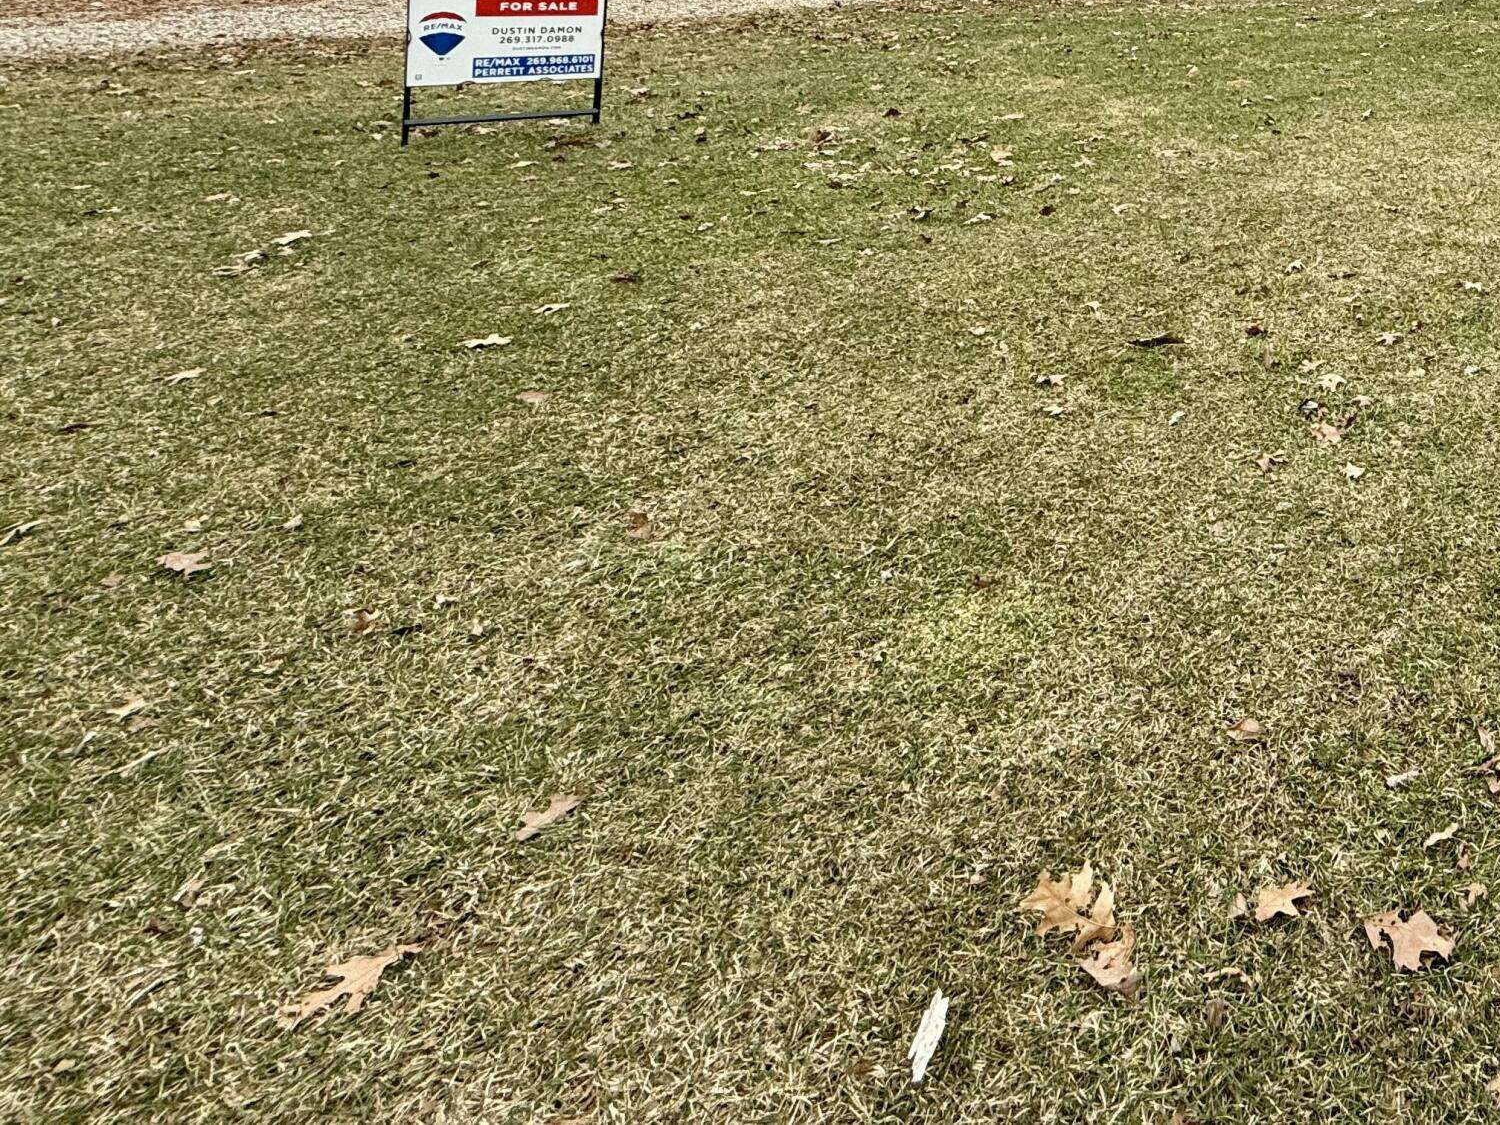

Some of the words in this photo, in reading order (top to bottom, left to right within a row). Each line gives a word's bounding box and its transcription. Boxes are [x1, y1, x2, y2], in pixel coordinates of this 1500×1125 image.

[500, 2, 533, 11] FOR
[538, 2, 578, 11] SALE
[423, 22, 463, 32] RE/MAX
[491, 27, 536, 35] DUSTIN
[540, 26, 582, 34] DAMON
[499, 35, 575, 44] 269.317.0988
[475, 58, 520, 67] RE/MAX
[526, 55, 593, 65] 269.968.6101
[475, 67, 524, 76] PERRETT
[528, 65, 593, 74] ASSOCIATES
